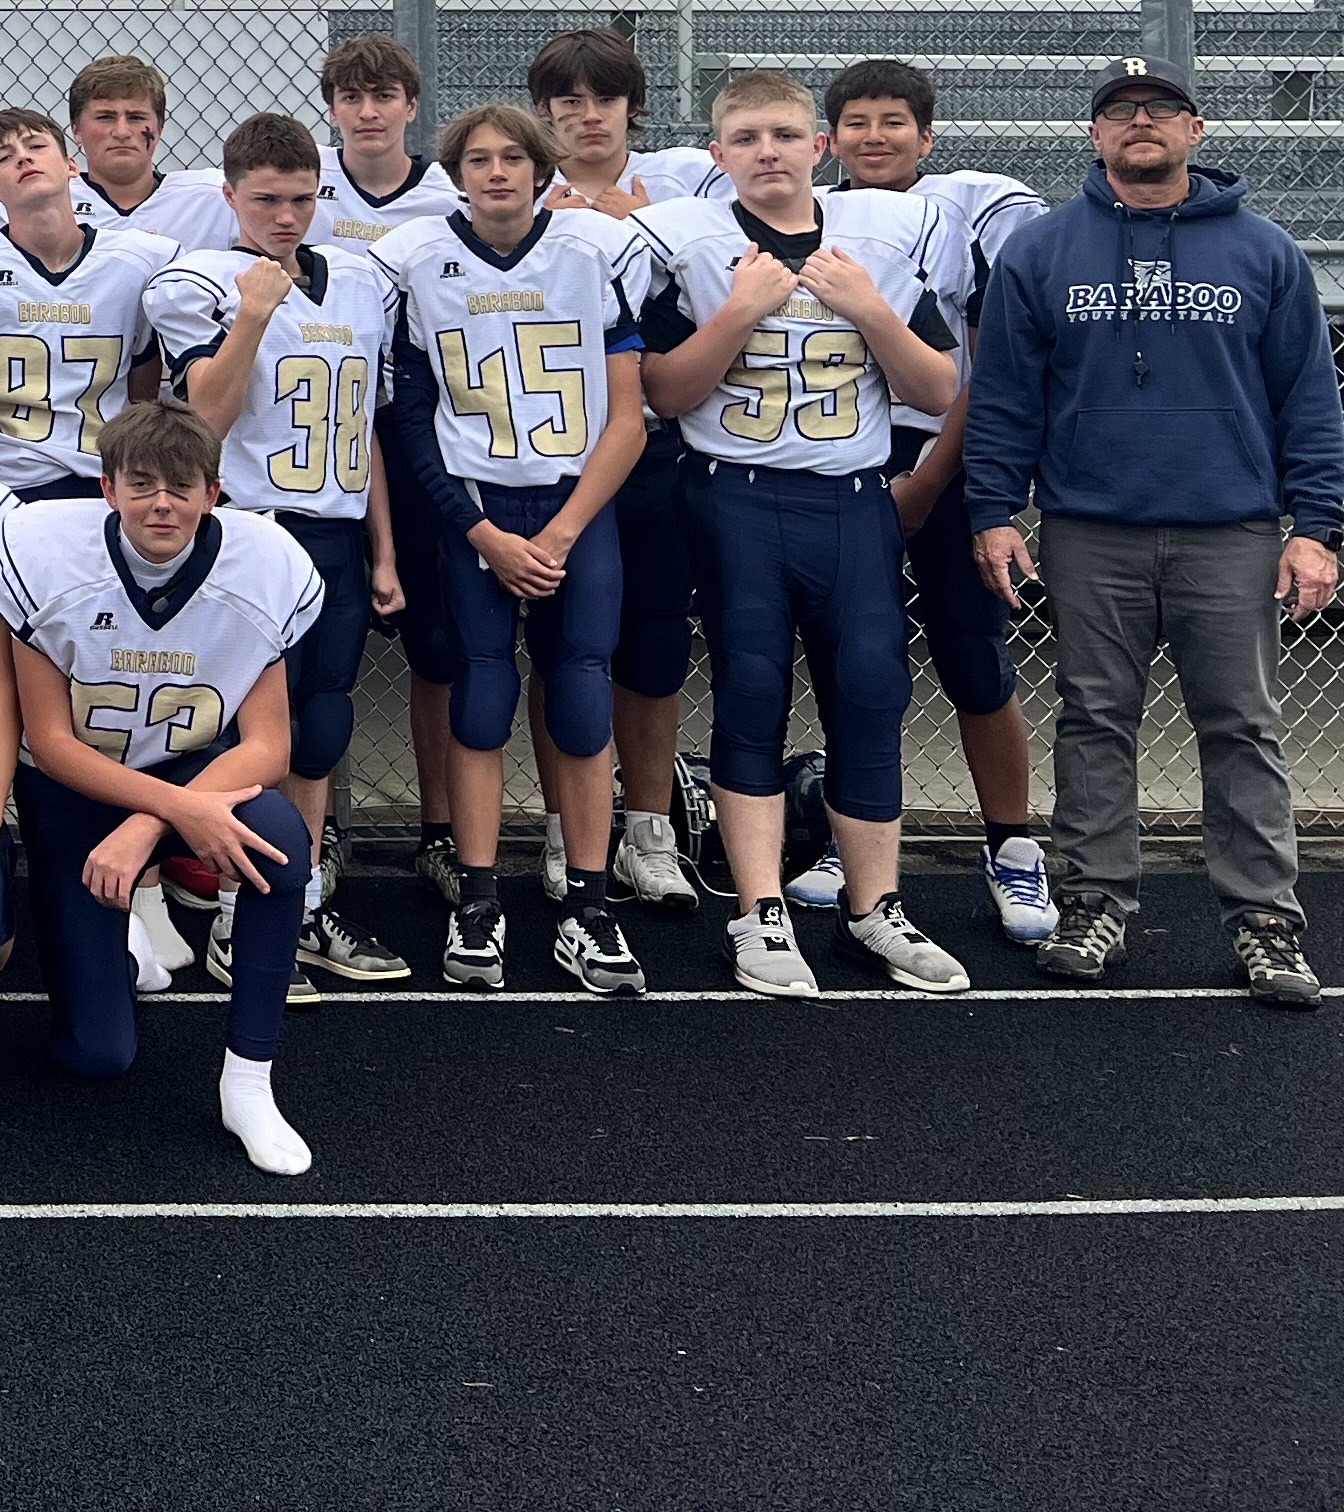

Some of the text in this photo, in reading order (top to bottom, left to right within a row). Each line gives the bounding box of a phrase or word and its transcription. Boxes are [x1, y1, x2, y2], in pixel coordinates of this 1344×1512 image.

[18, 301, 91, 324] BARABOO
[467, 291, 545, 315] BARABOO
[1066, 283, 1242, 314] BARABOO
[1068, 311, 1235, 324] YOUTH FOOTBALL
[436, 320, 588, 458] 45
[267, 355, 370, 494] 38
[111, 648, 197, 676] BARABOO
